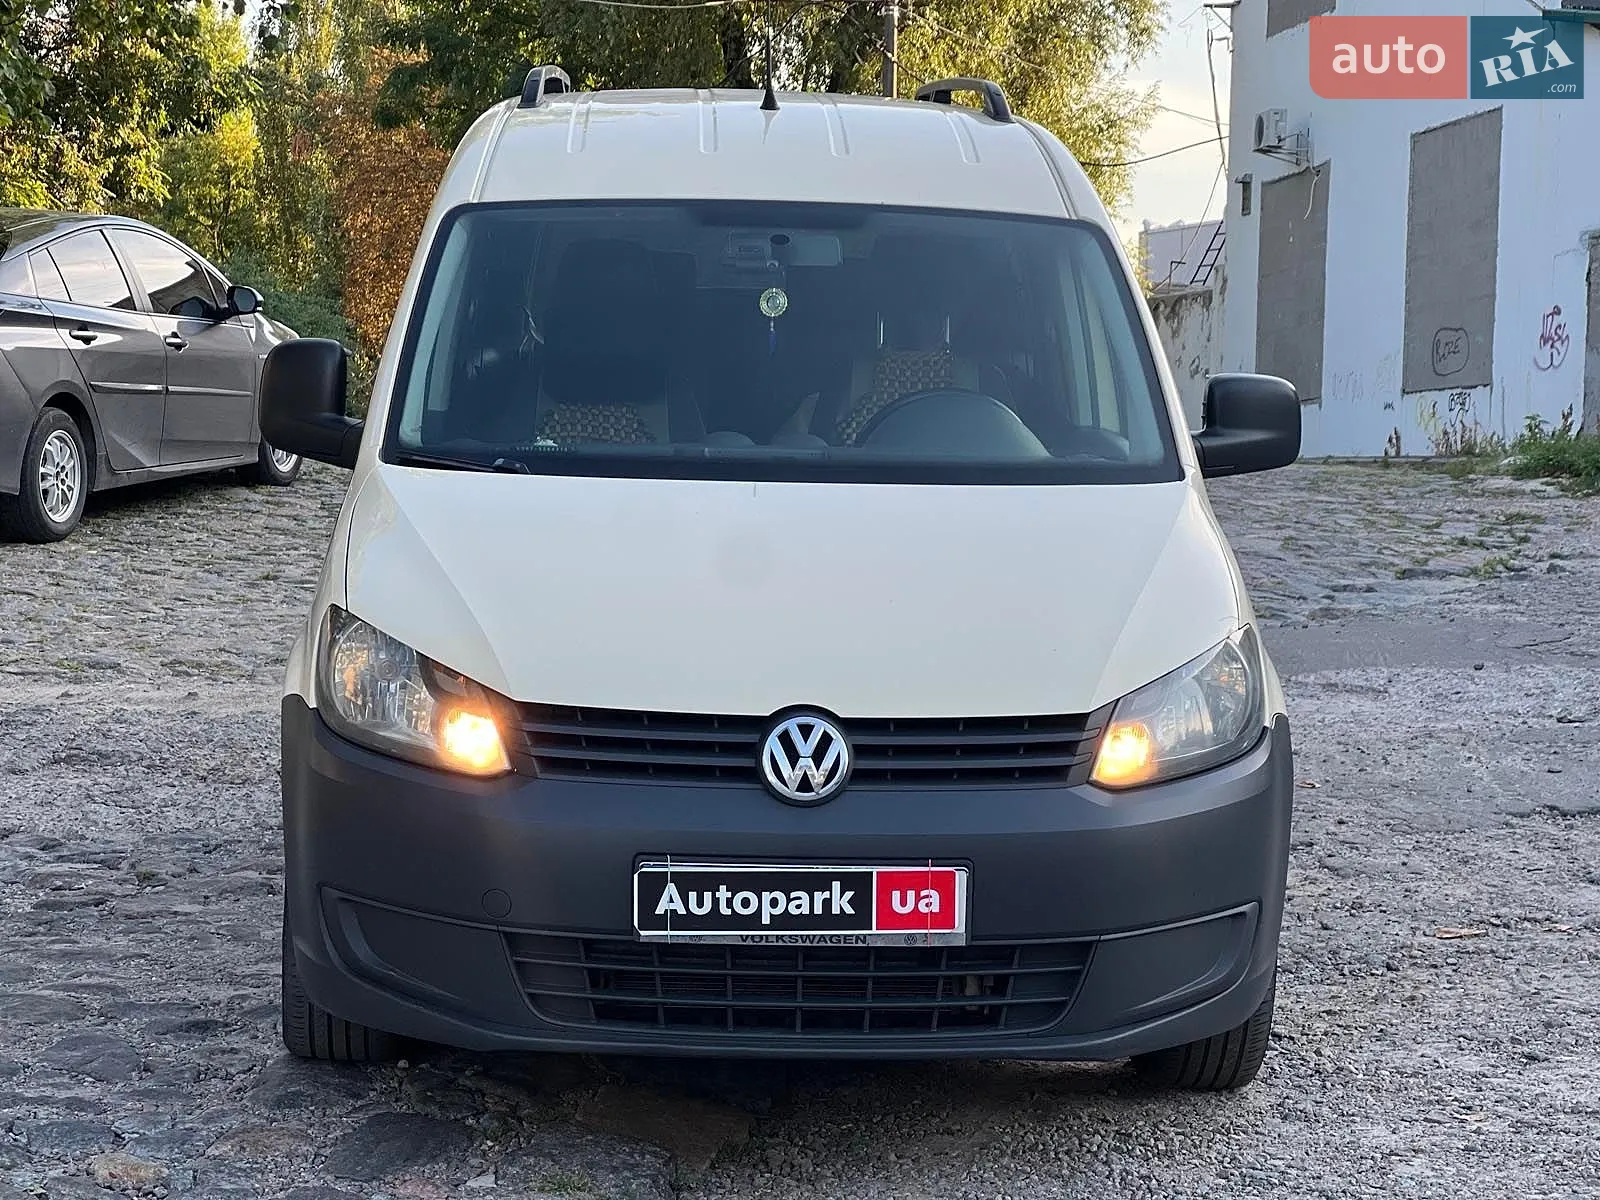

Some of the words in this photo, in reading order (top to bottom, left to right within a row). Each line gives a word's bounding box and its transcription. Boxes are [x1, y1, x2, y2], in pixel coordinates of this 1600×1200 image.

[654, 881, 856, 925] Autopark
[891, 889, 940, 914] ua
[739, 933, 867, 946] VOLKSWAGEN
